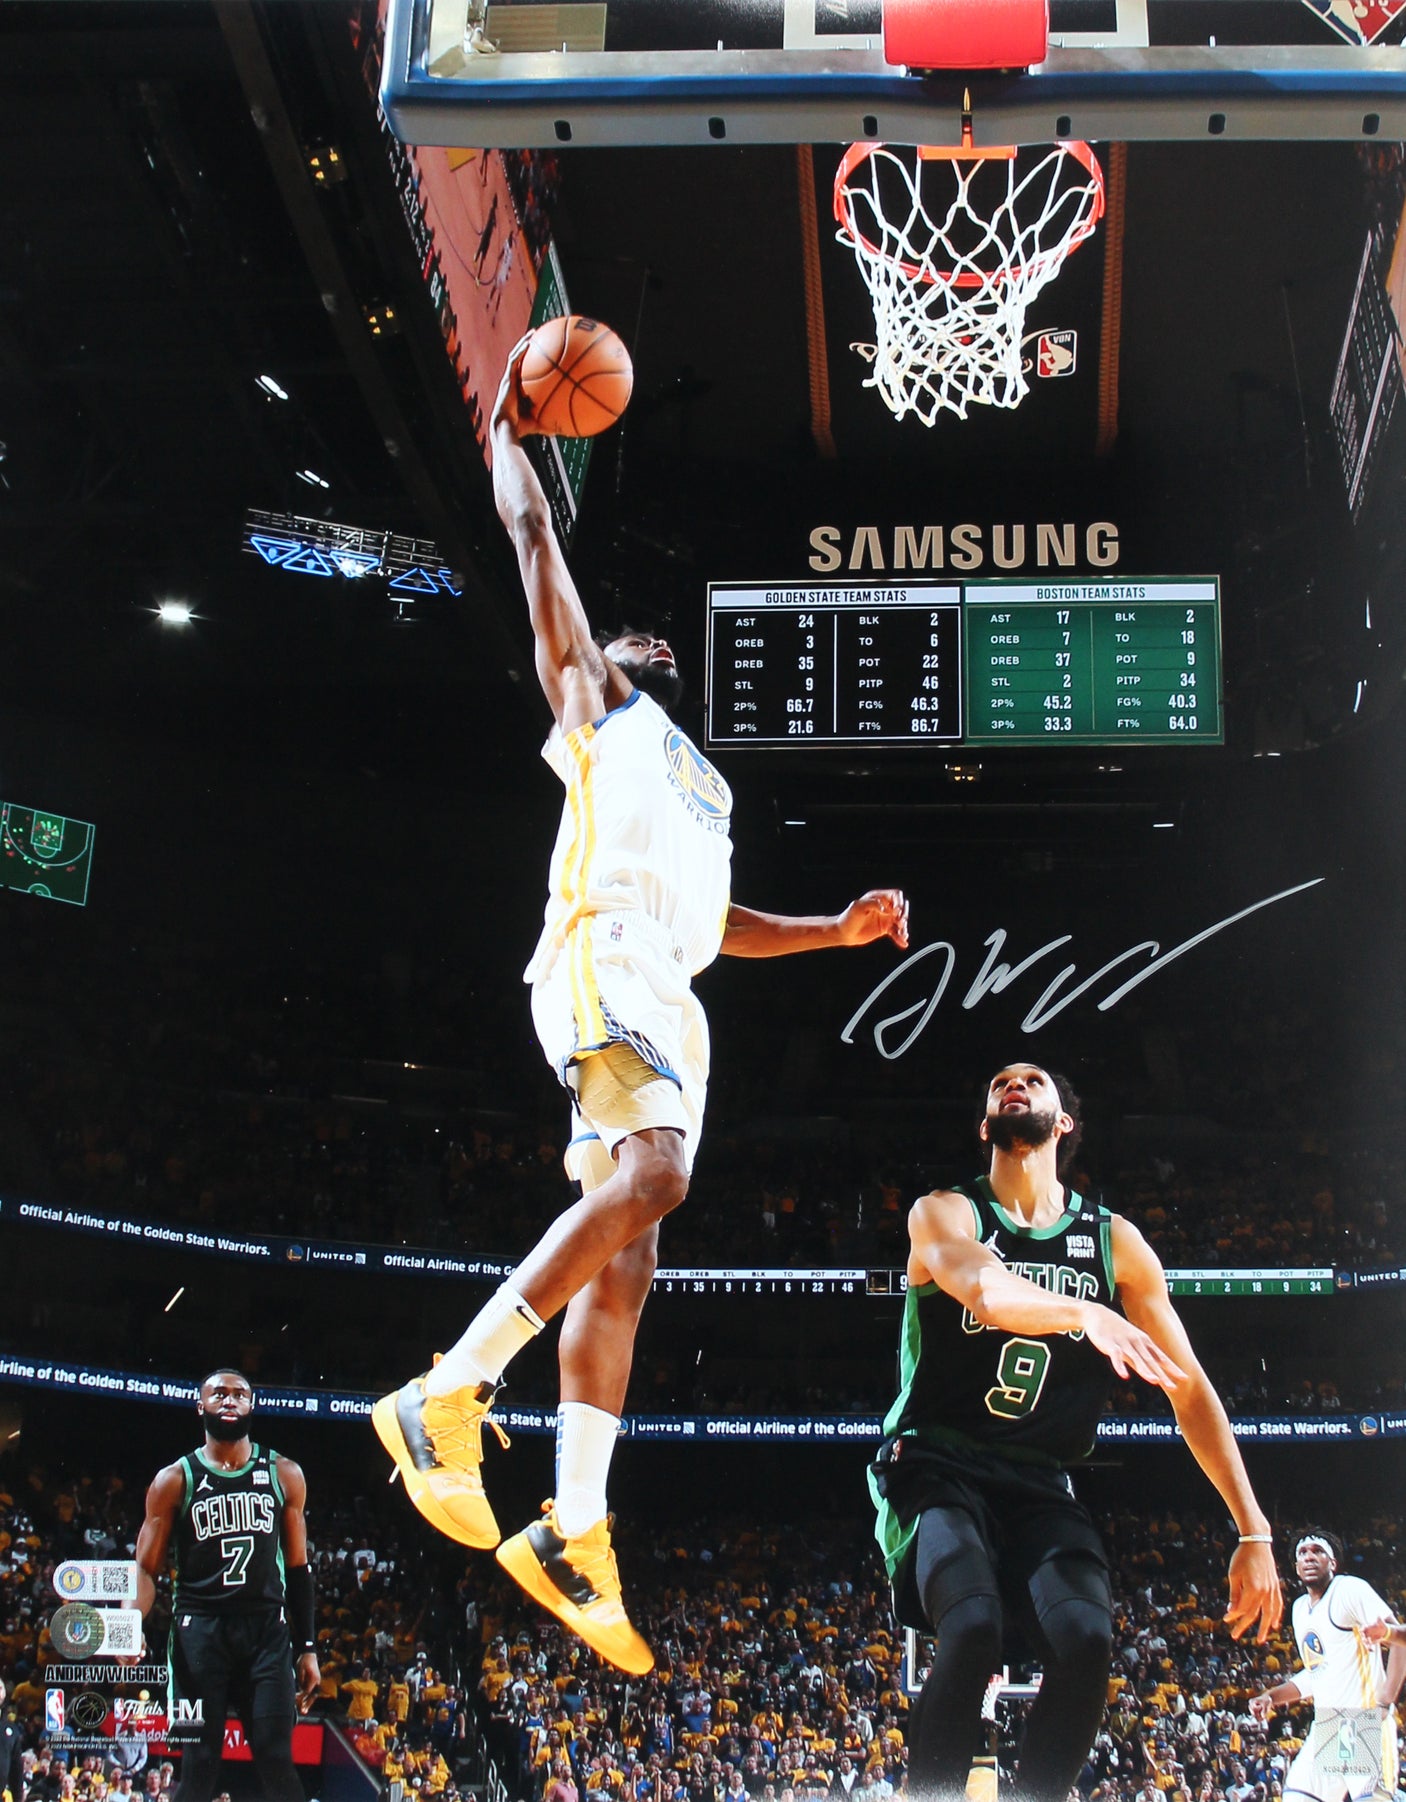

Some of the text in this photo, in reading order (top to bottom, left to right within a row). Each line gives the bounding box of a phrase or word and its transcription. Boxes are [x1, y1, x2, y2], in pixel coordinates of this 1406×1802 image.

[808, 521, 1120, 572] SAMSUNG
[766, 591, 906, 603] GOLDEN STATE TEAM STATS
[1037, 587, 1145, 599] BOSTON TEAM STATS
[736, 615, 814, 627] AST 24
[860, 613, 938, 626] BLK 2
[991, 611, 1069, 624] AST 17
[1116, 610, 1194, 622] BLK 2
[735, 636, 813, 648] OREB 3
[931, 634, 938, 646] 6
[991, 632, 1070, 645] OREB 7
[1116, 631, 1194, 644] TO 18
[735, 657, 813, 669] DREB 35
[859, 655, 938, 668] POT 22
[991, 653, 1070, 666] DREB 37
[1117, 652, 1194, 665] POT 9
[735, 678, 813, 690] STL 9
[923, 676, 938, 689] 46
[992, 674, 1071, 687] STL 2
[1117, 673, 1195, 686] PITP 34
[787, 699, 813, 712] 66.7
[859, 697, 938, 710] FG% 46.3
[991, 696, 1071, 709] 2P% 45.2
[1118, 695, 1196, 708] FG% 40.3
[734, 720, 813, 733] 3P% 21.6
[859, 719, 938, 732] FT% 86.7
[992, 717, 1071, 730] 3P% 33.3
[1118, 716, 1196, 729] FT% 64.0
[20, 1205, 270, 1255] Official Airline of the Golden State Warriors.
[1066, 1235, 1095, 1248] VISTA
[313, 1252, 353, 1260] UNITED
[1067, 1247, 1095, 1258] PRINT
[384, 1255, 424, 1268] Official
[427, 1259, 465, 1271] Airline
[468, 1263, 480, 1272] of
[483, 1264, 501, 1274] the
[1359, 1272, 1399, 1283] UNITED
[667, 1282, 853, 1292] 3 35 9 2 6 22 46
[1195, 1282, 1201, 1292] 2
[1225, 1282, 1230, 1292] 2
[1253, 1282, 1261, 1292] 18
[1284, 1282, 1289, 1292] 9
[1310, 1282, 1321, 1291] 34
[0, 1360, 200, 1402] irline of the Golden State Warri
[984, 1337, 1051, 1419] 9
[259, 1398, 303, 1407] UNITED
[510, 1413, 542, 1426] State
[1387, 1419, 1406, 1429] UNI
[707, 1422, 880, 1434] Official Airline of the Golden
[1130, 1423, 1172, 1435] Airline
[1260, 1423, 1291, 1434] State
[1294, 1422, 1351, 1434] Warriors.
[191, 1491, 275, 1542] CELTICS
[221, 1535, 254, 1586] 7
